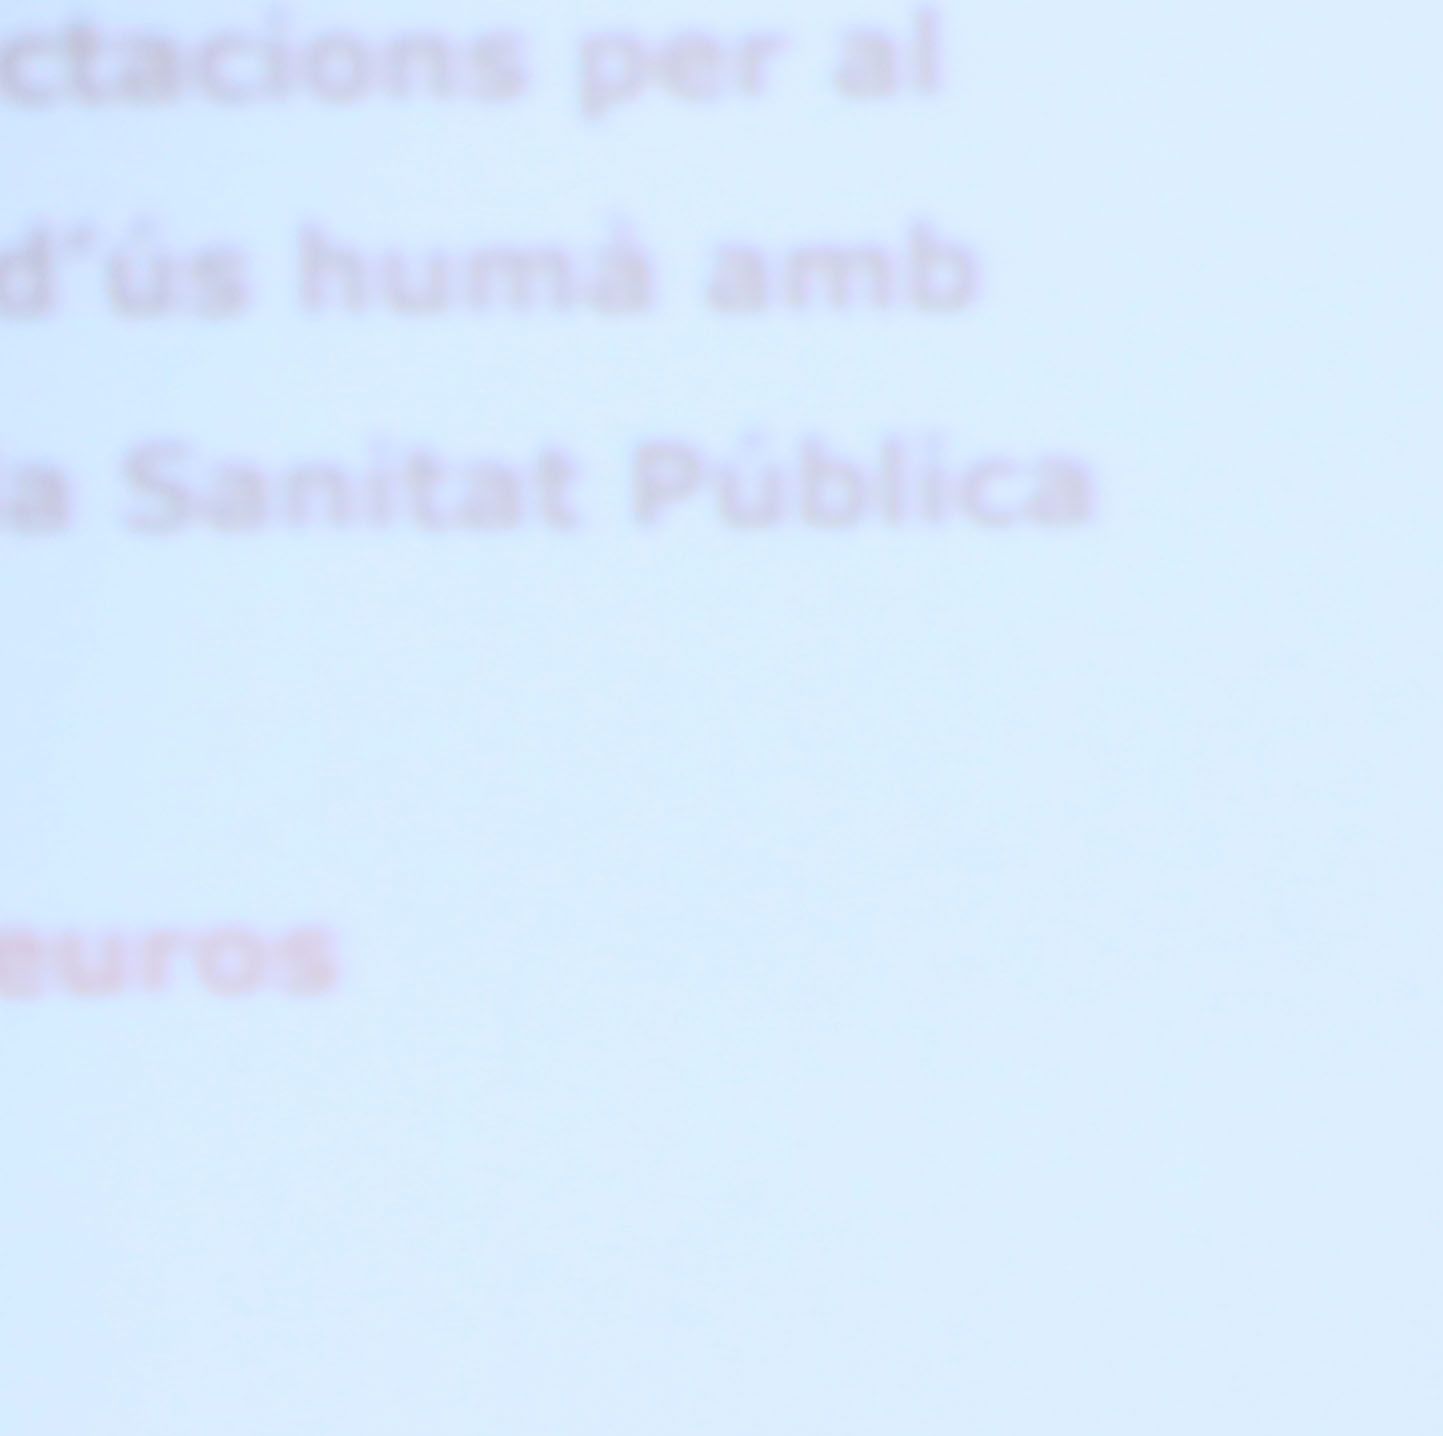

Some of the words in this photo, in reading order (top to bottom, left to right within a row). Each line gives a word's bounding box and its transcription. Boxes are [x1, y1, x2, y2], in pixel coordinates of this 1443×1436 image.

[578, 28, 790, 121] per
[834, 3, 945, 100] al
[297, 204, 660, 318] humà
[705, 217, 984, 316] amb
[120, 437, 582, 536] Sanitat
[631, 430, 1100, 531] Pública
